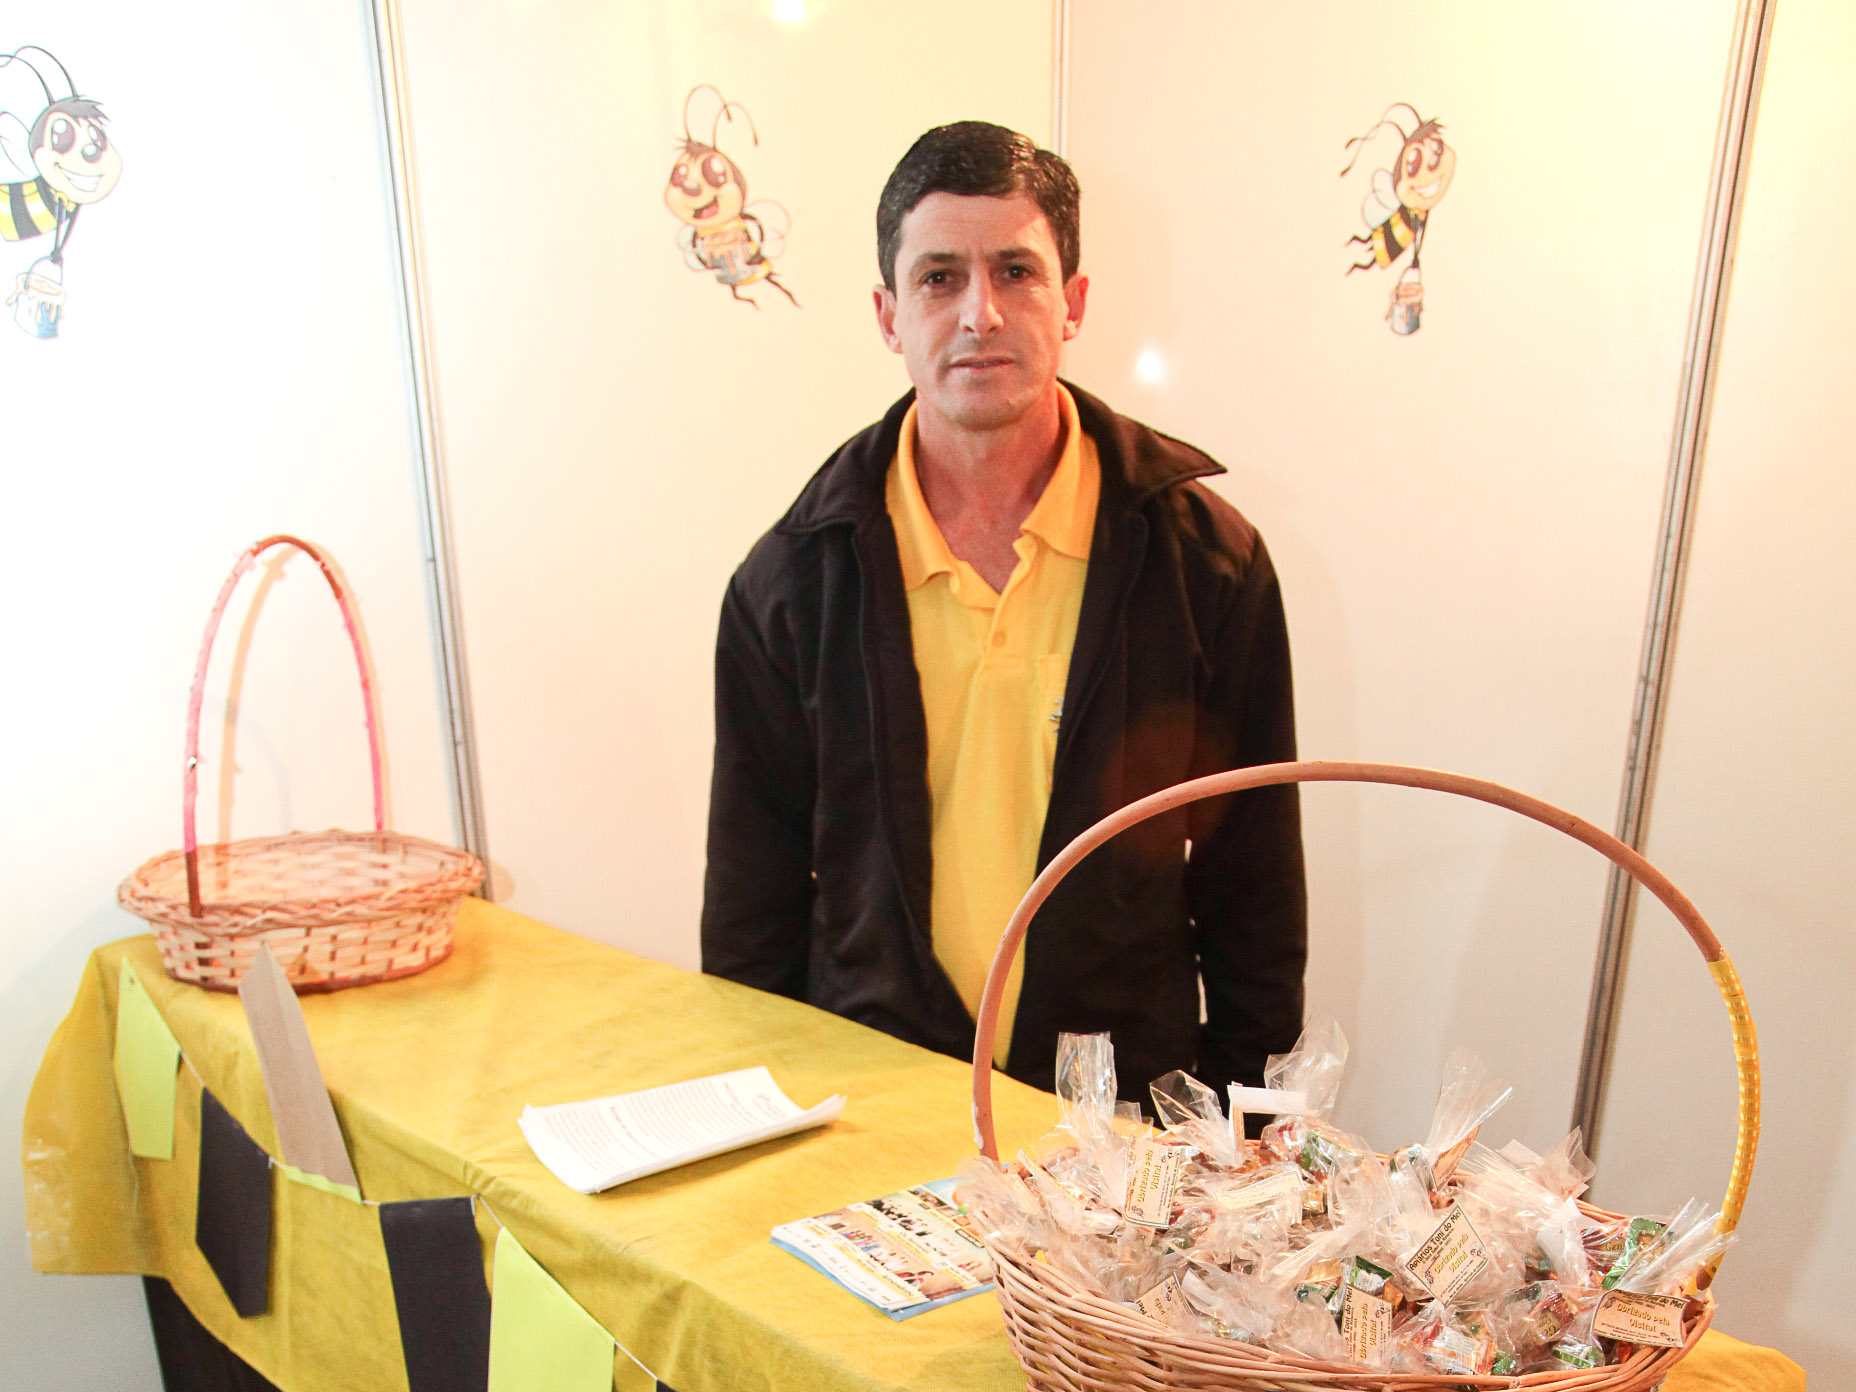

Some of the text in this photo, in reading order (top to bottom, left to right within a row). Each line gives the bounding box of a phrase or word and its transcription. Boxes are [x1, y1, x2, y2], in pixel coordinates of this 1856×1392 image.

[1408, 1245, 1433, 1271] Apiários
[1431, 1232, 1445, 1246] Toni
[1443, 1222, 1453, 1232] do
[1345, 1287, 1353, 1304] Mel
[1669, 1299, 1684, 1310] Mel
